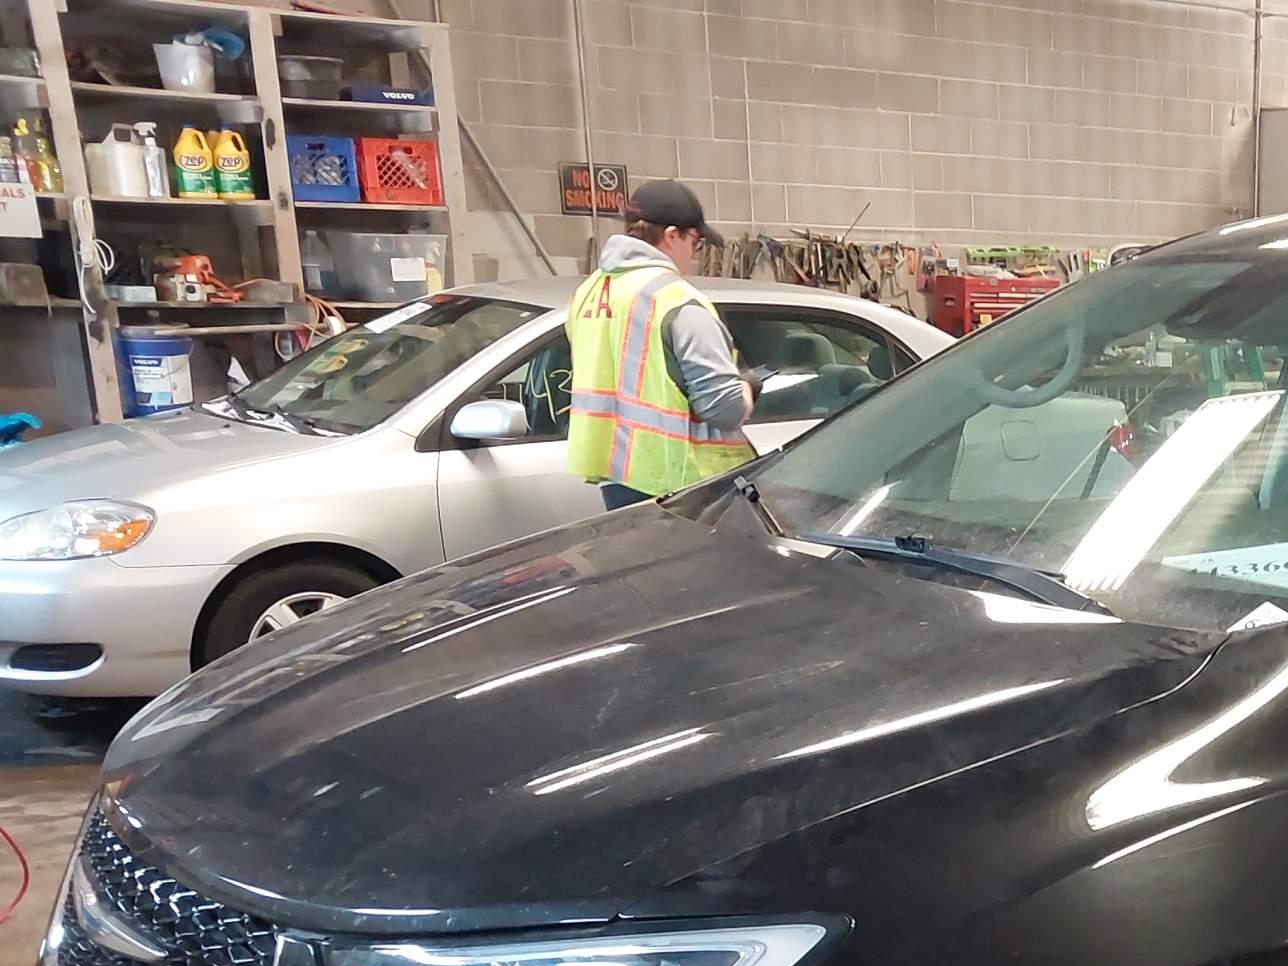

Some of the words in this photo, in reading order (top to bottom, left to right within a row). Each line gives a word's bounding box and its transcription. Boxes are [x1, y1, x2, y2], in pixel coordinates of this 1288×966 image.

[382, 91, 415, 99] VOLVO
[572, 168, 590, 188] NO
[0, 186, 26, 199] ALS
